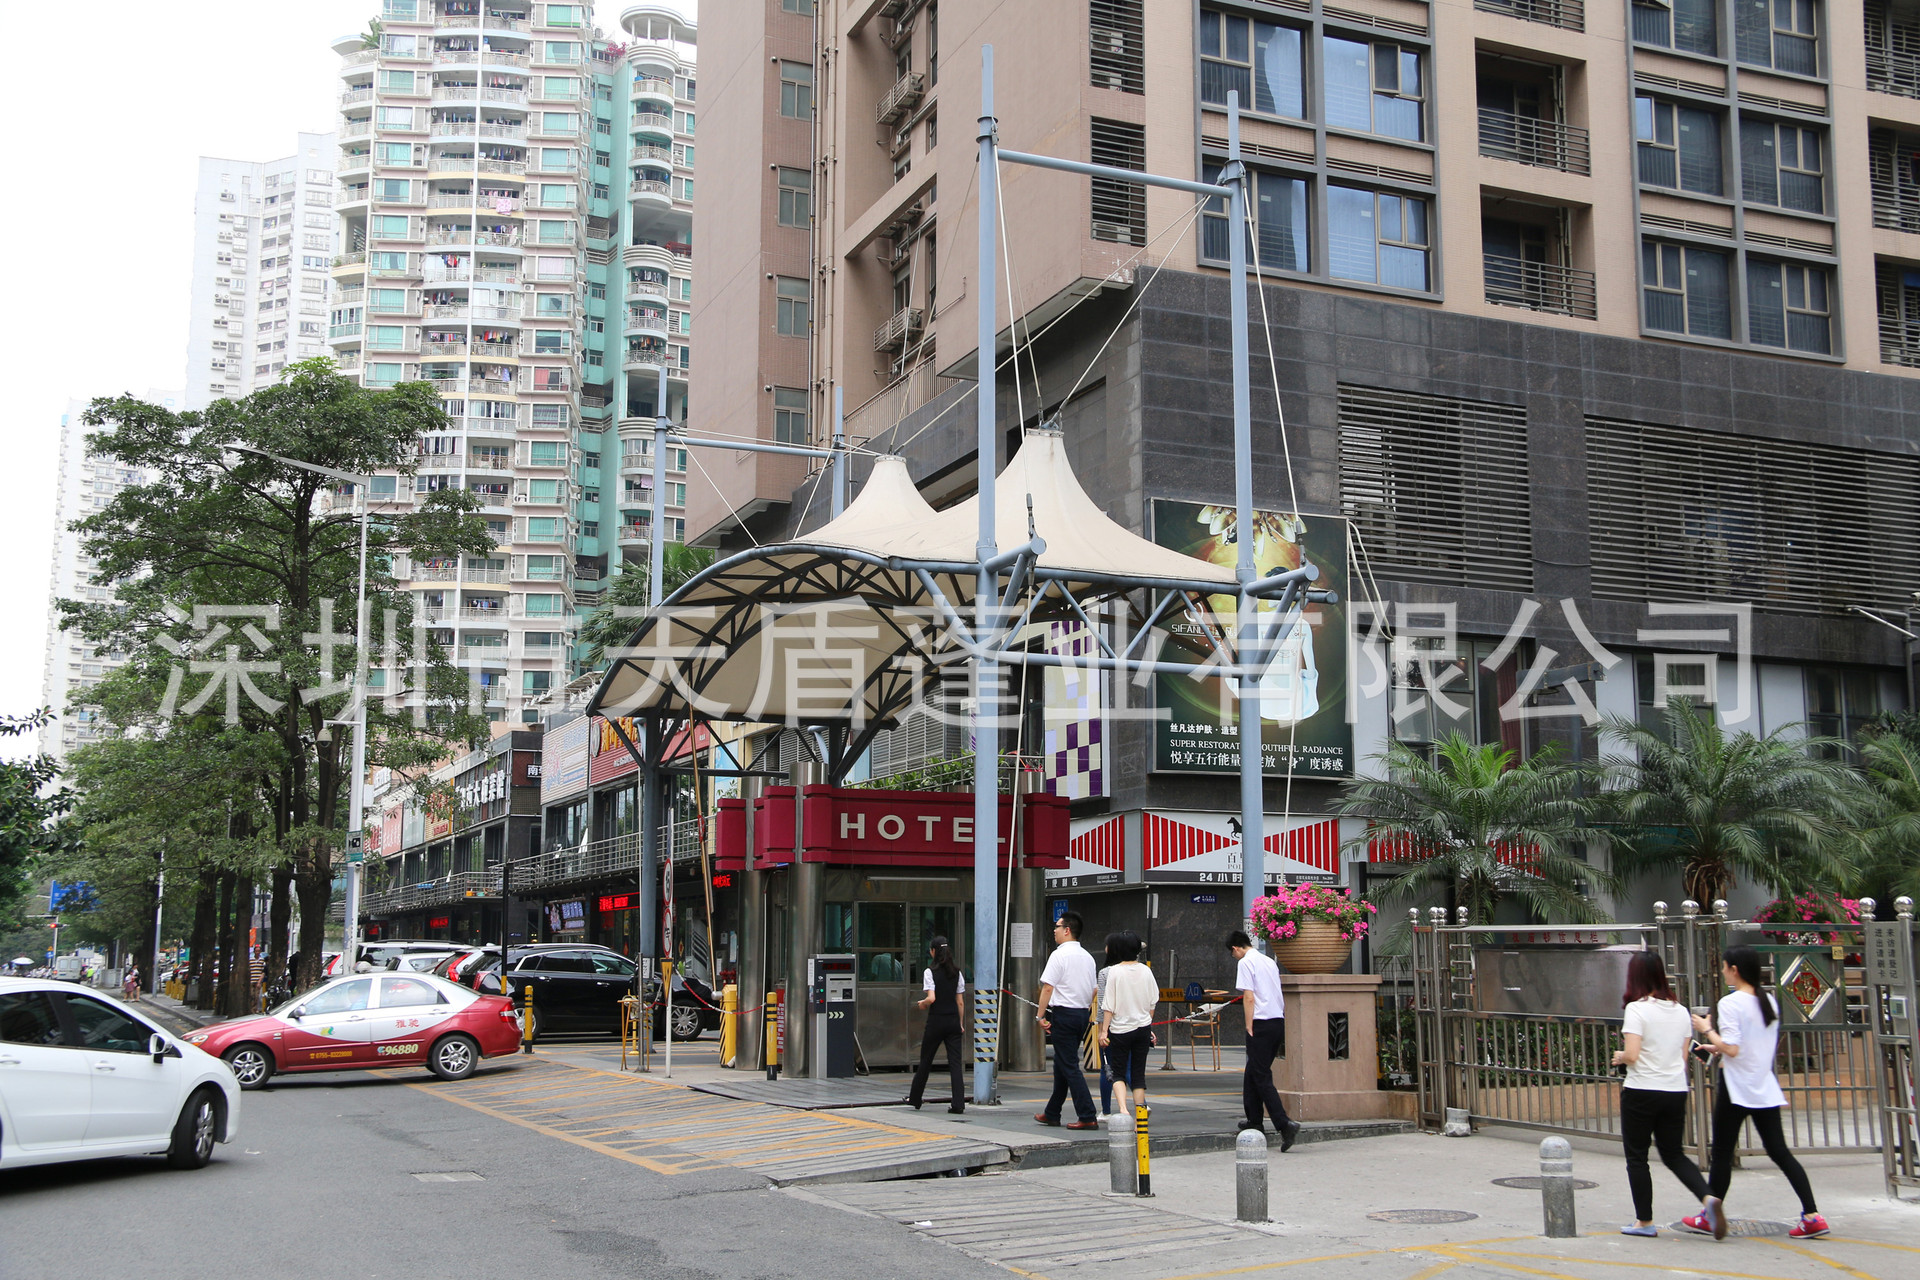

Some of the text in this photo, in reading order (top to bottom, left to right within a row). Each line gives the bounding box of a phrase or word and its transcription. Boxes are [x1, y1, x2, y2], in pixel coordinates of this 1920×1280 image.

[1170, 739, 1197, 748] SUPER
[1261, 743, 1299, 753] OUTHFUL
[1302, 746, 1343, 755] RADIANCE
[840, 812, 1006, 844] HOTE
[385, 1044, 419, 1056] 96880
